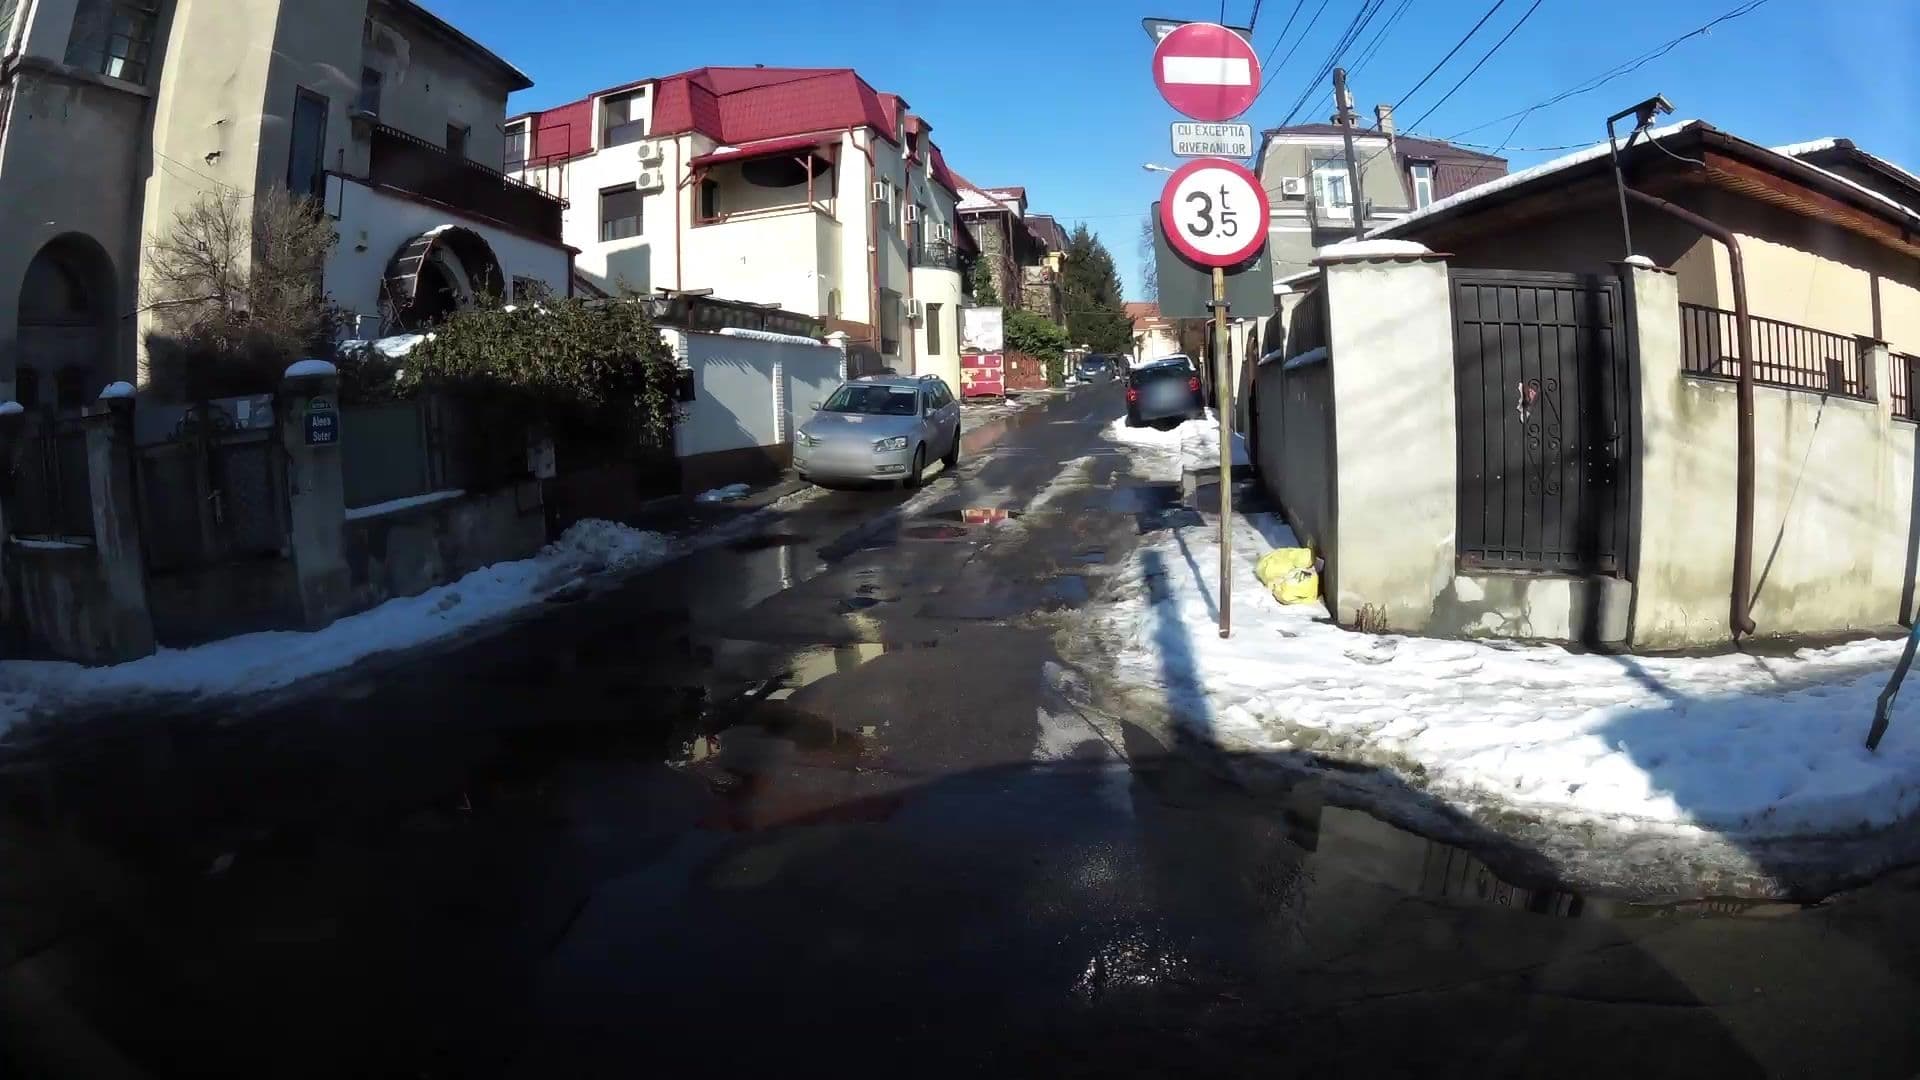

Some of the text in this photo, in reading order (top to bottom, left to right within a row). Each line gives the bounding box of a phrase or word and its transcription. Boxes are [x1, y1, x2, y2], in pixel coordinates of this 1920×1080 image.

[1177, 124, 1245, 137] CU EXCEPTIA
[1178, 141, 1246, 154] RIVERANILOR
